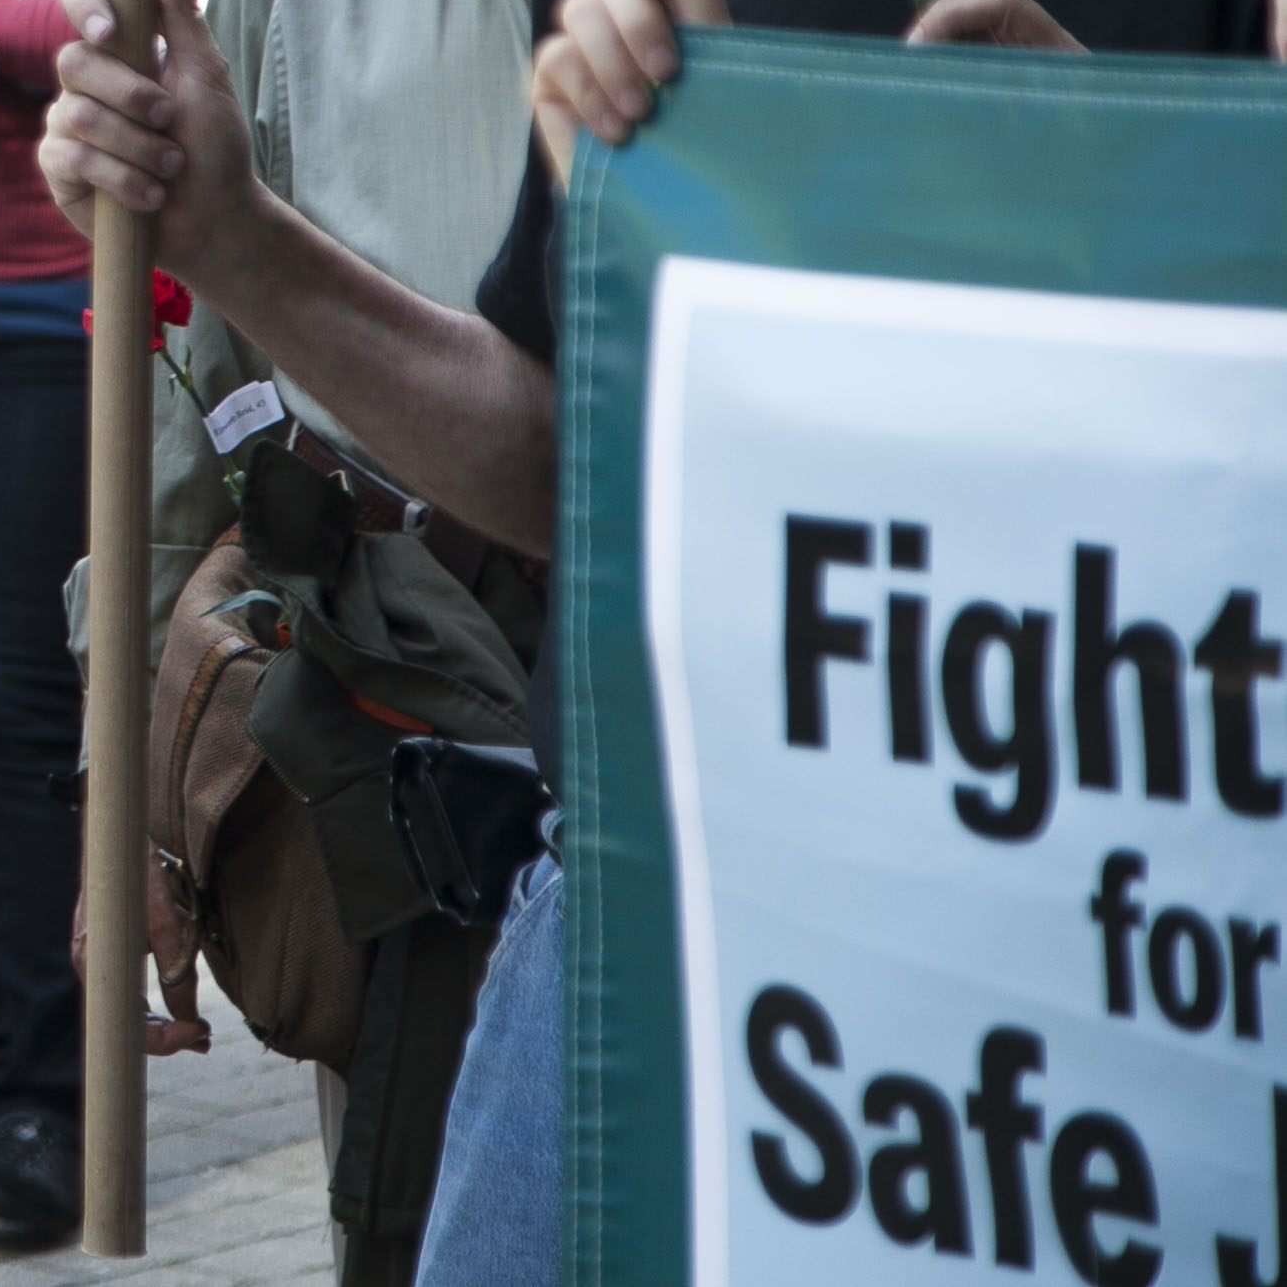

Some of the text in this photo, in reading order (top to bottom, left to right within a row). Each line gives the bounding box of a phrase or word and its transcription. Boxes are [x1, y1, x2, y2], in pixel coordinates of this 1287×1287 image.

[784, 511, 1285, 846] Fight
[1090, 847, 1283, 1045] for
[744, 981, 1164, 1287] Safe
